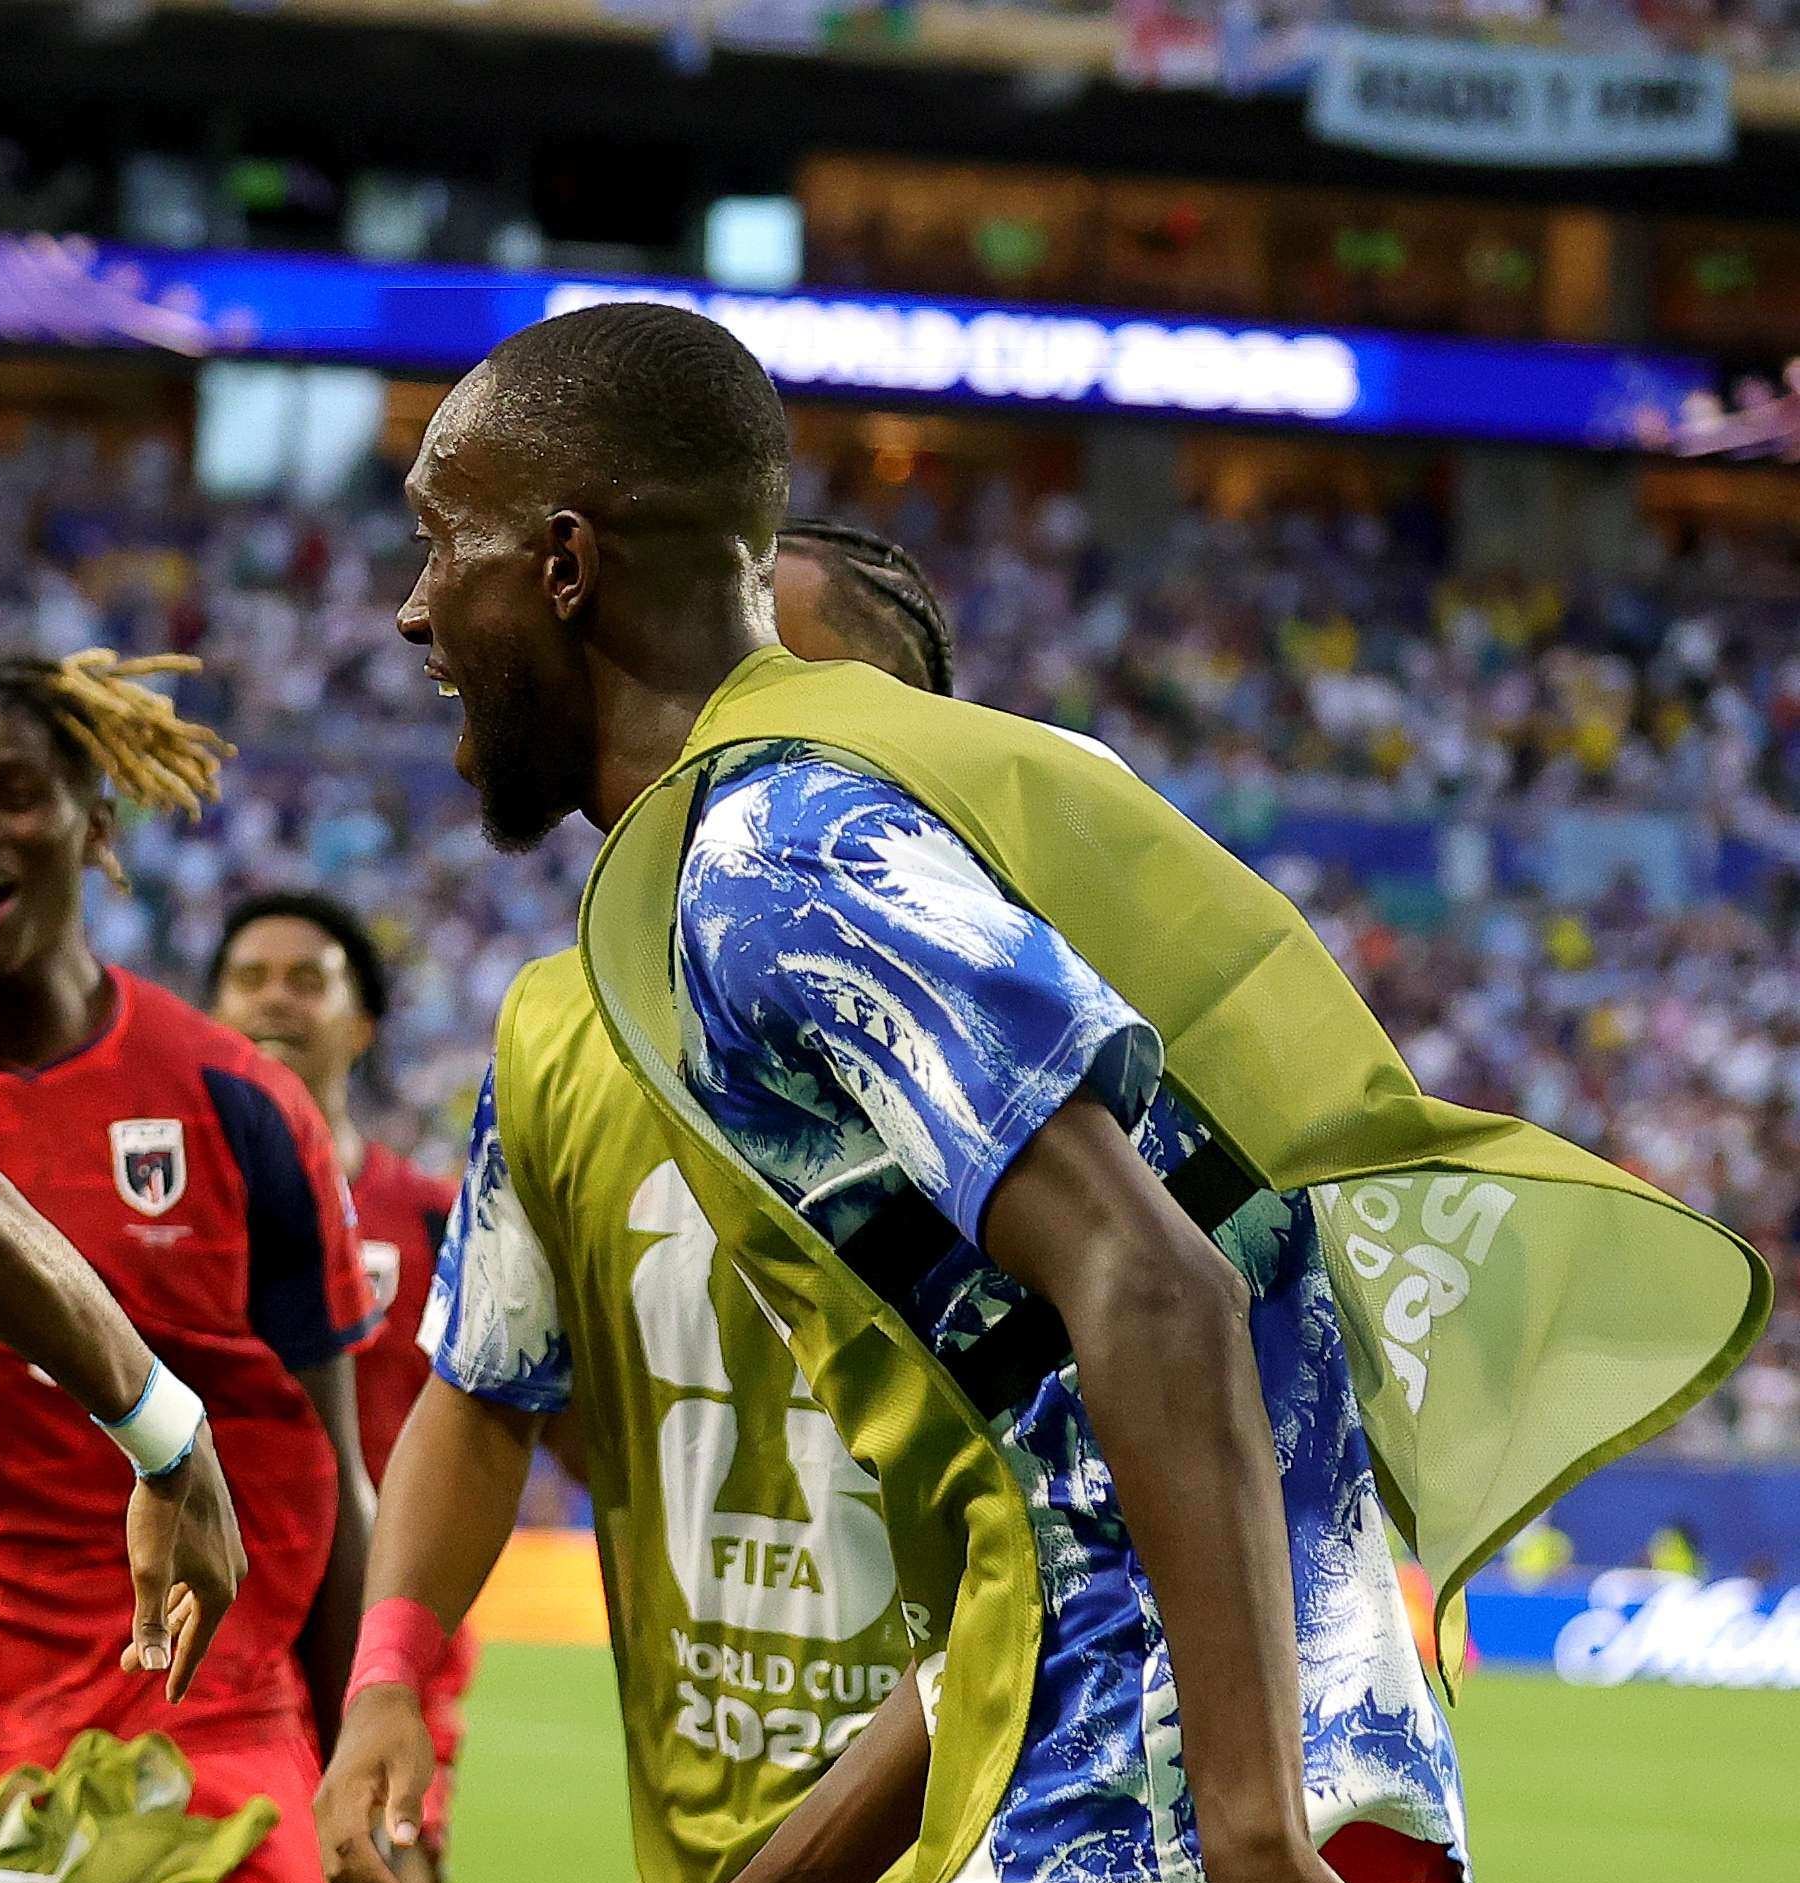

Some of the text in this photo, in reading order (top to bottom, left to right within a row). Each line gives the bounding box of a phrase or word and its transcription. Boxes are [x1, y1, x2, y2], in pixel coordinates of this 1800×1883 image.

[711, 1536, 824, 1594] FIFA
[671, 1627, 900, 1705] WORLD CUP
